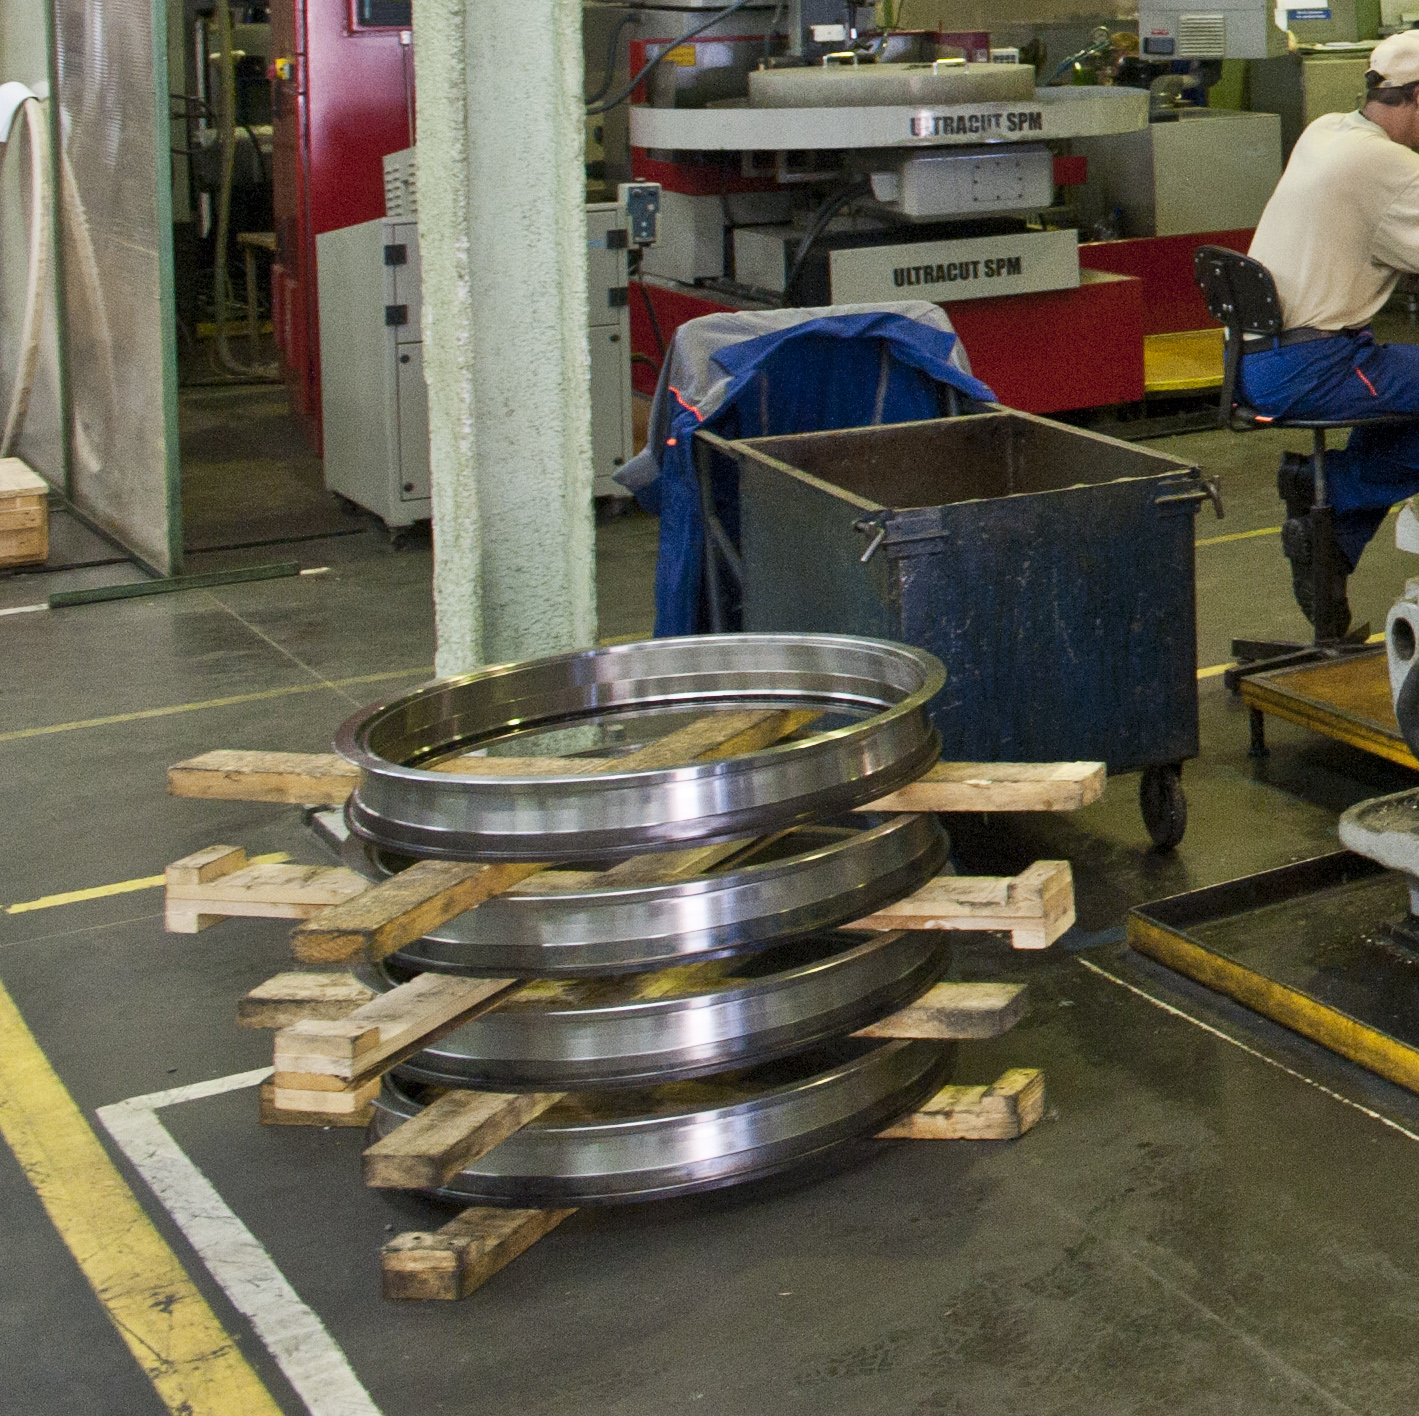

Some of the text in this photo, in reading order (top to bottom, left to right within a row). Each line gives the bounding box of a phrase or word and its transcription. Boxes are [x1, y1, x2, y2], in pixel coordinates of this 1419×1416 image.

[910, 112, 1043, 136] UTRACUT SPM
[893, 257, 1022, 287] ULTRACUT SPM
